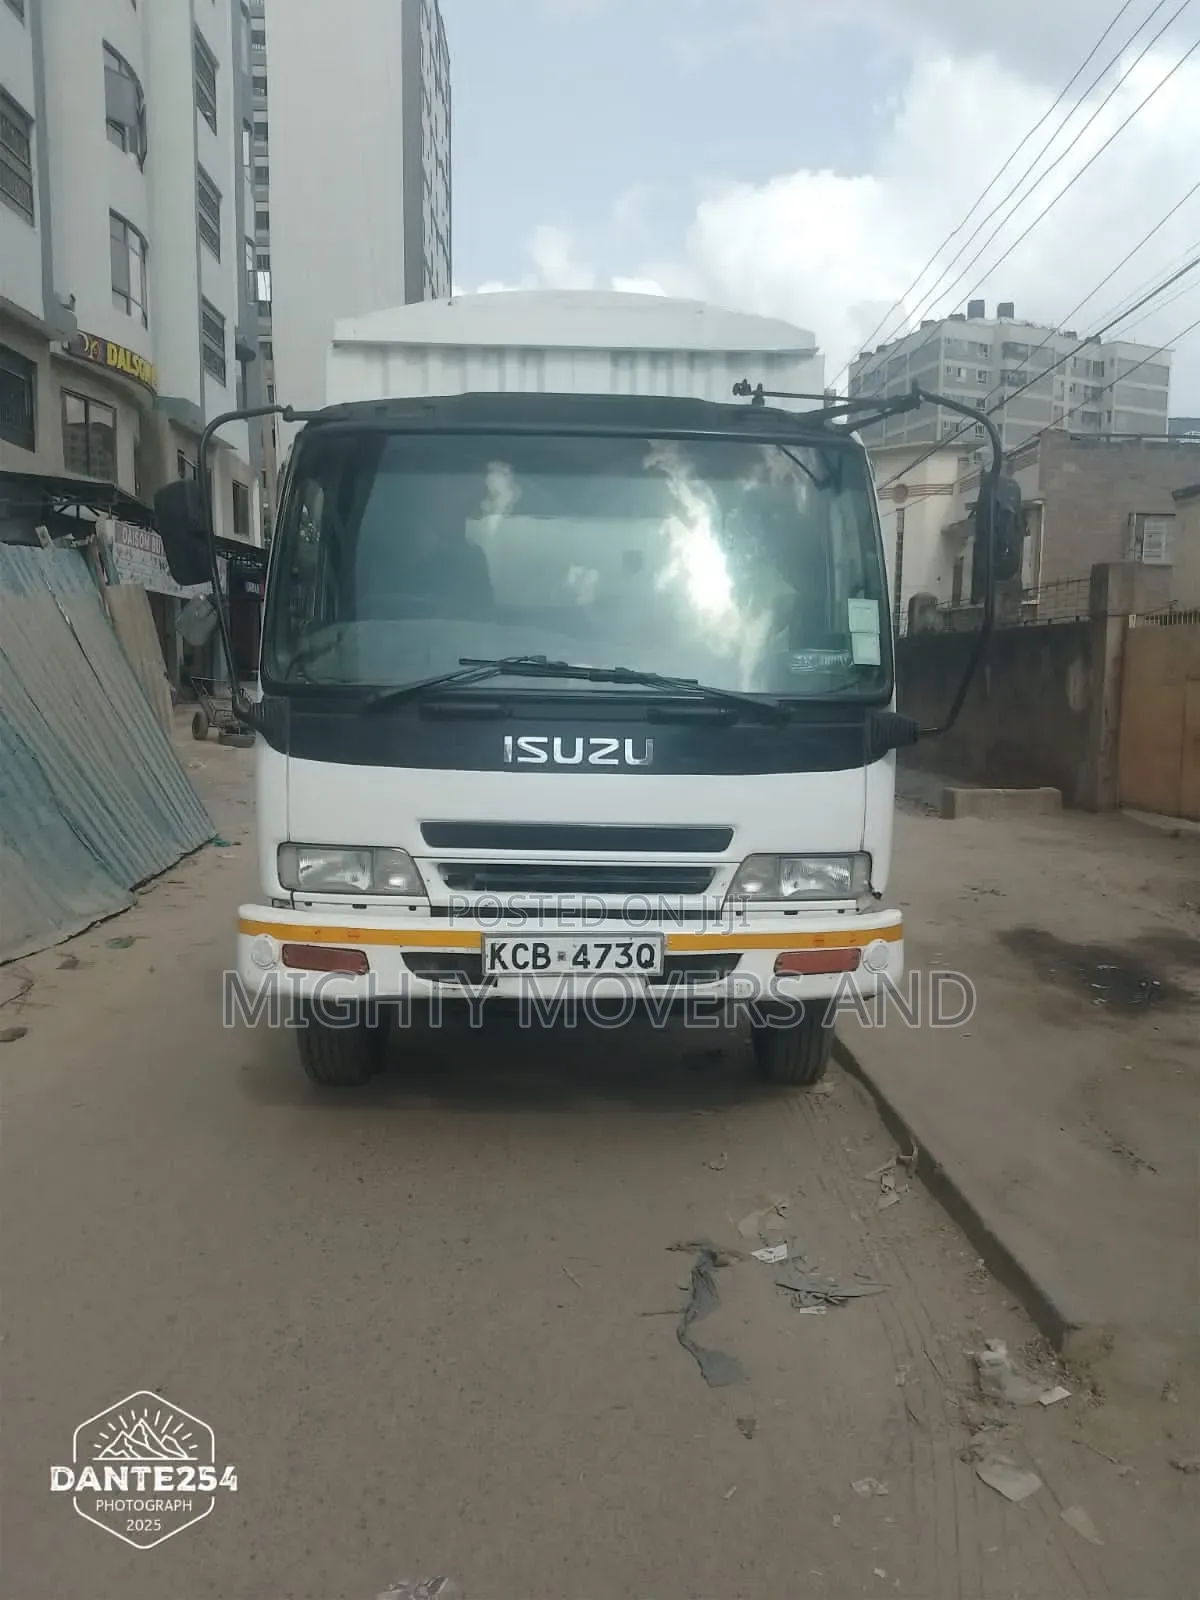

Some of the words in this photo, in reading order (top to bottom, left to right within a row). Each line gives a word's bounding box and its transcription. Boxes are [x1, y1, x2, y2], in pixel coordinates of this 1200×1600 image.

[503, 735, 654, 765] ISUZU
[488, 942, 552, 970] KCB
[571, 942, 656, 970] 473Q
